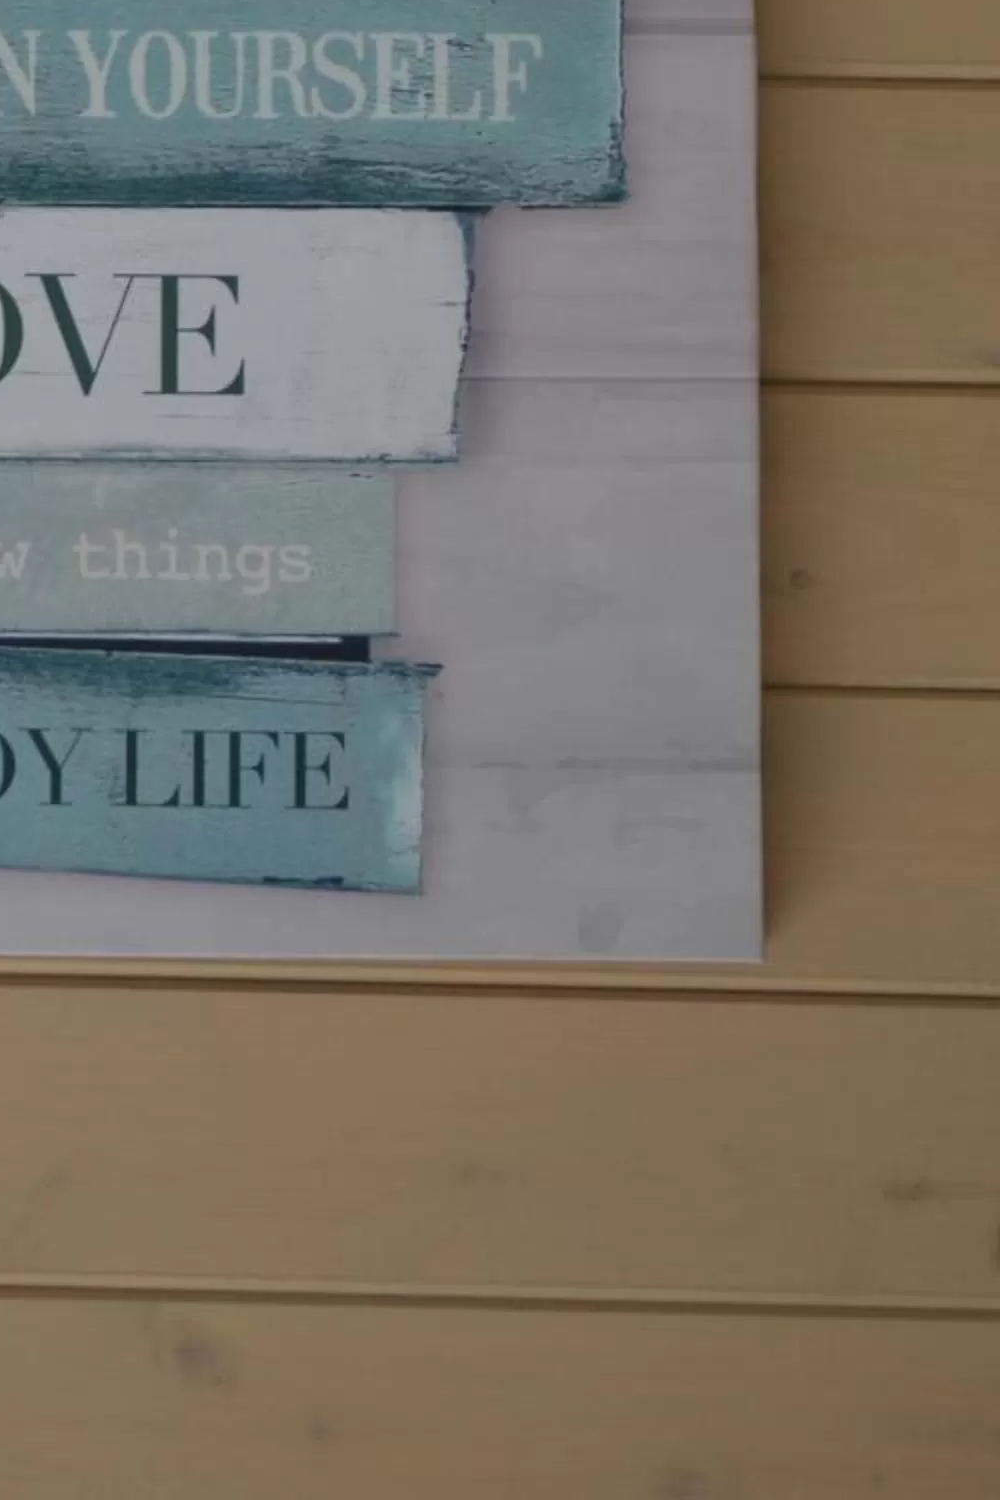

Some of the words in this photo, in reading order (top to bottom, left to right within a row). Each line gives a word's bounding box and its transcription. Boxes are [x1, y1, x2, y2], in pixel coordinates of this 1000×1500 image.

[68, 29, 543, 123] YOURSELF
[73, 528, 313, 595] things
[113, 729, 351, 810] LIFE
